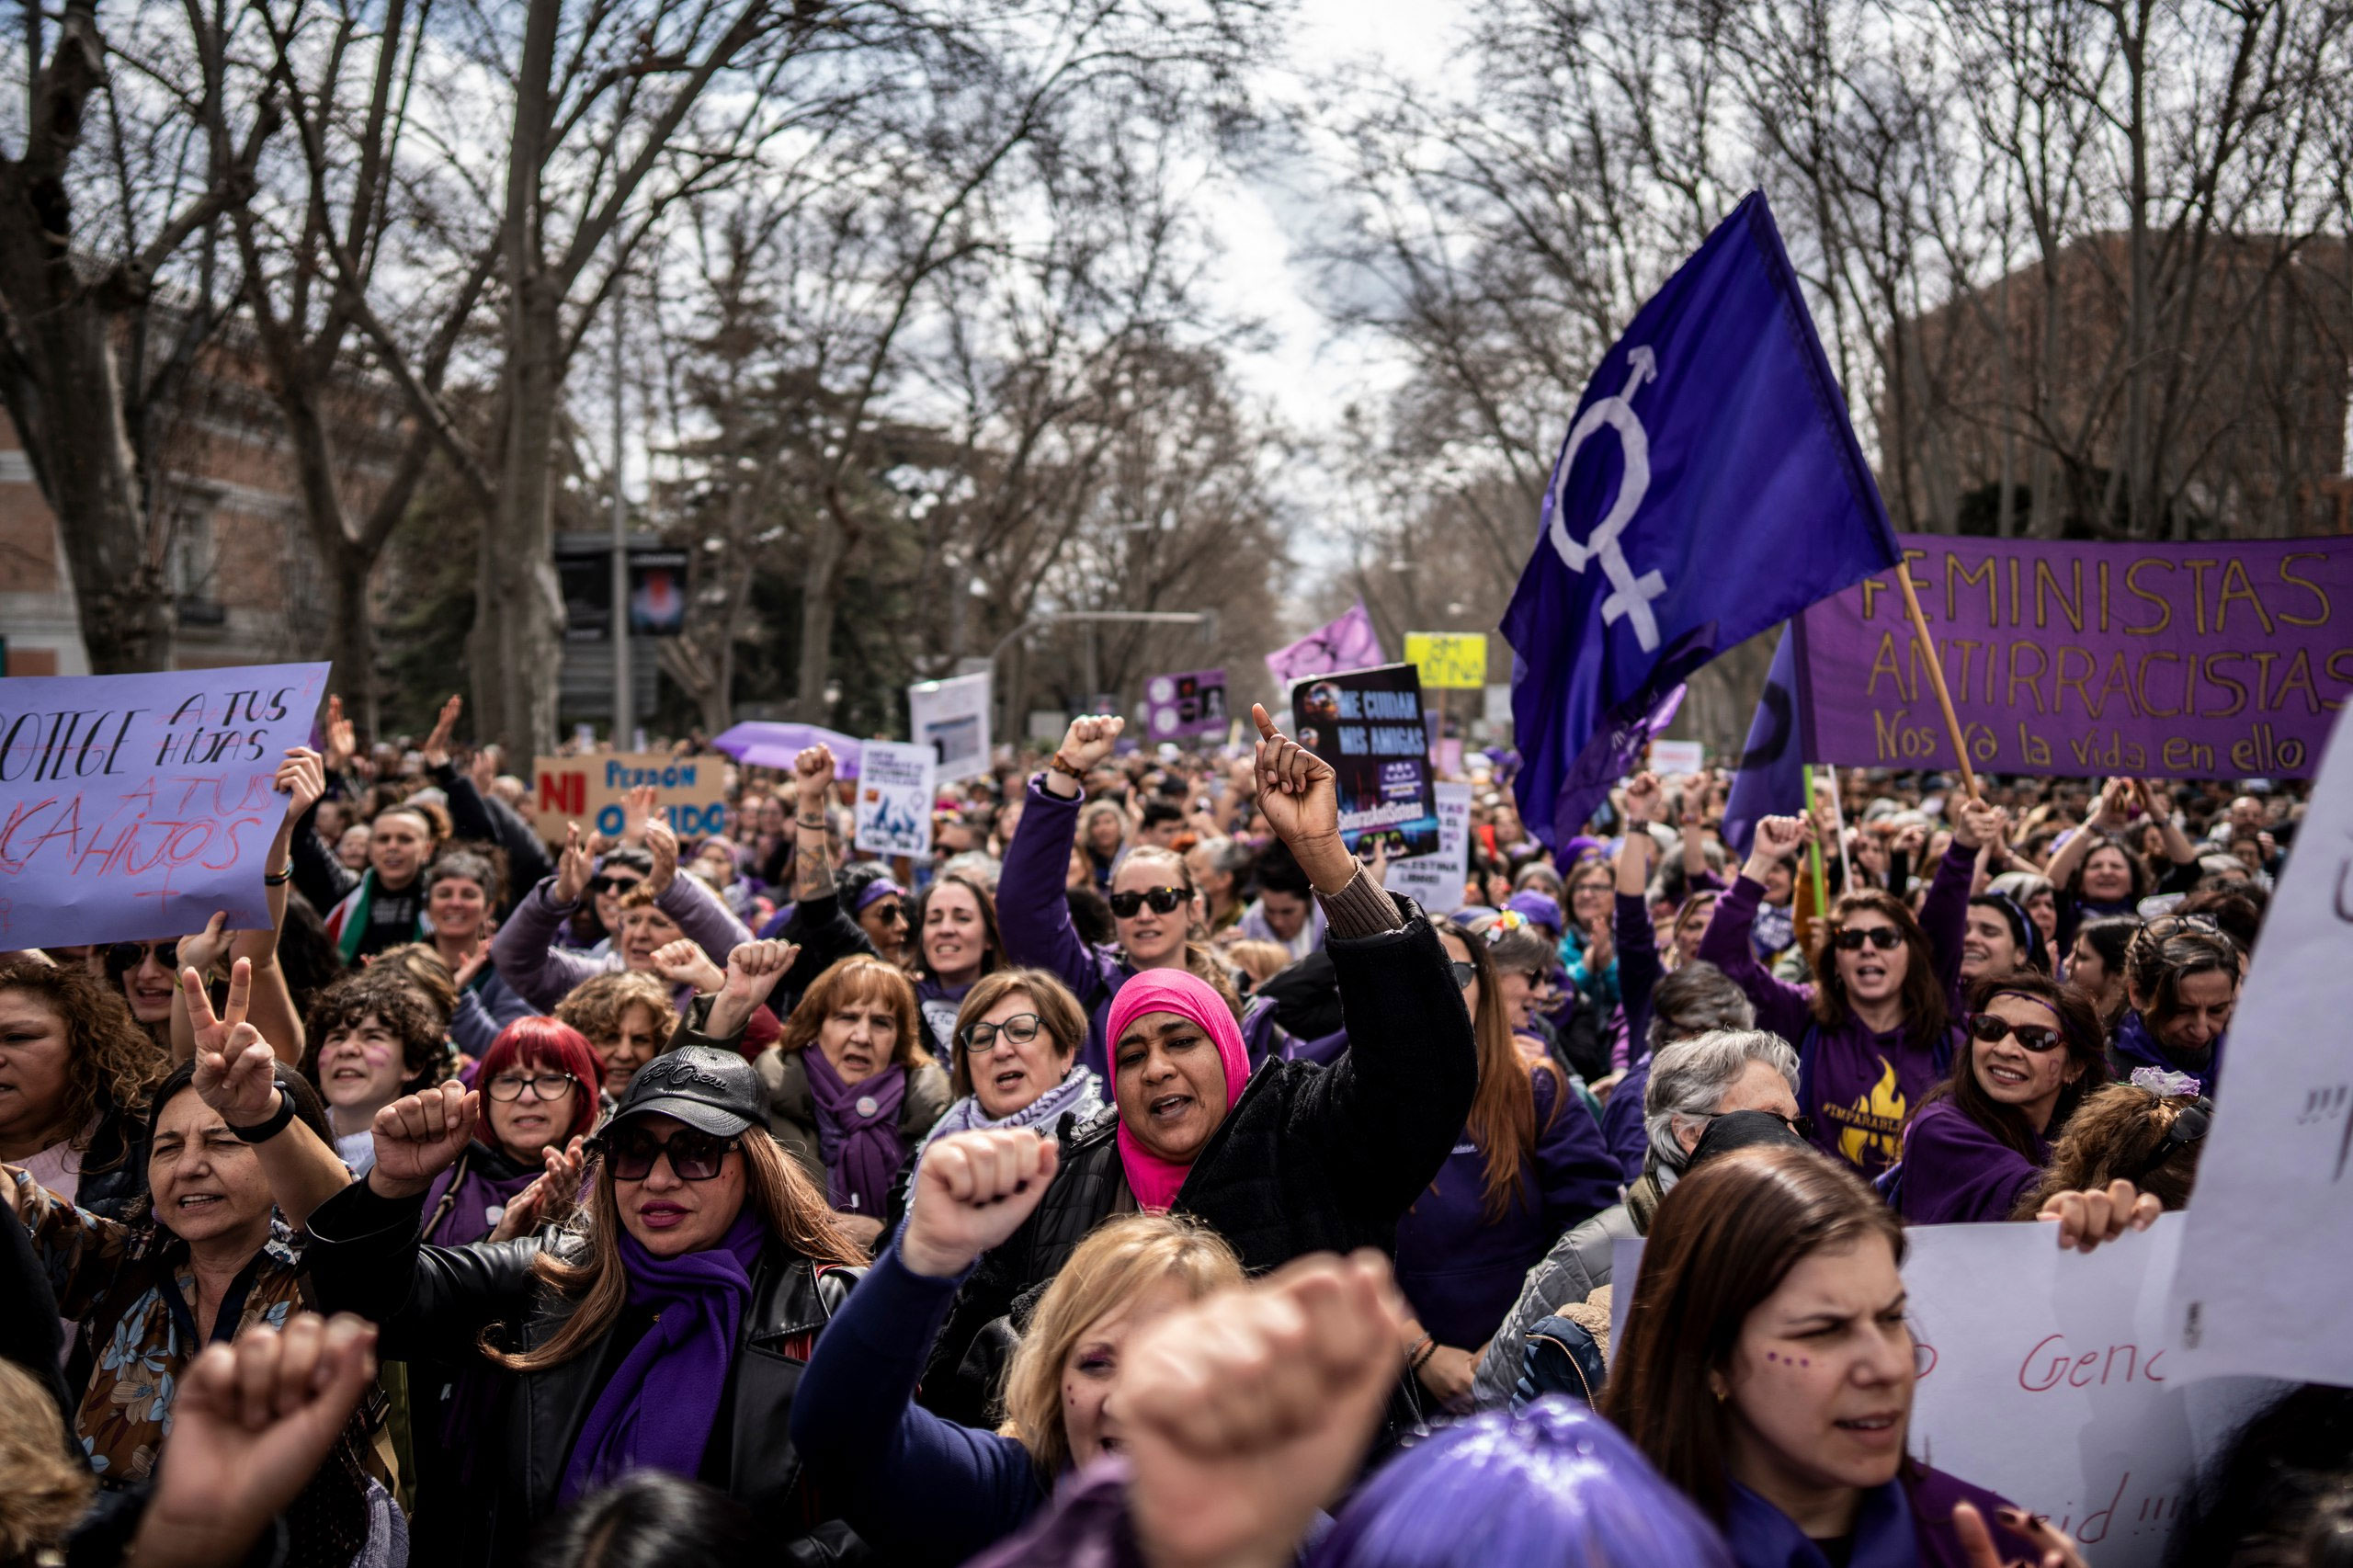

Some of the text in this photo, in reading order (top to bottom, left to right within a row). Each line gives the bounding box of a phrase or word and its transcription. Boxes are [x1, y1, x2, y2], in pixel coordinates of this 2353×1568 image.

[1862, 549, 2331, 636] FEMINISTAS
[1867, 630, 2353, 721] ANTIRRACISTAS
[169, 687, 296, 726] A TUS
[0, 709, 151, 782] OTEGE
[2163, 736, 2216, 772] en
[2231, 722, 2306, 772] ello
[540, 770, 586, 816] NI
[597, 801, 725, 836] OIDO
